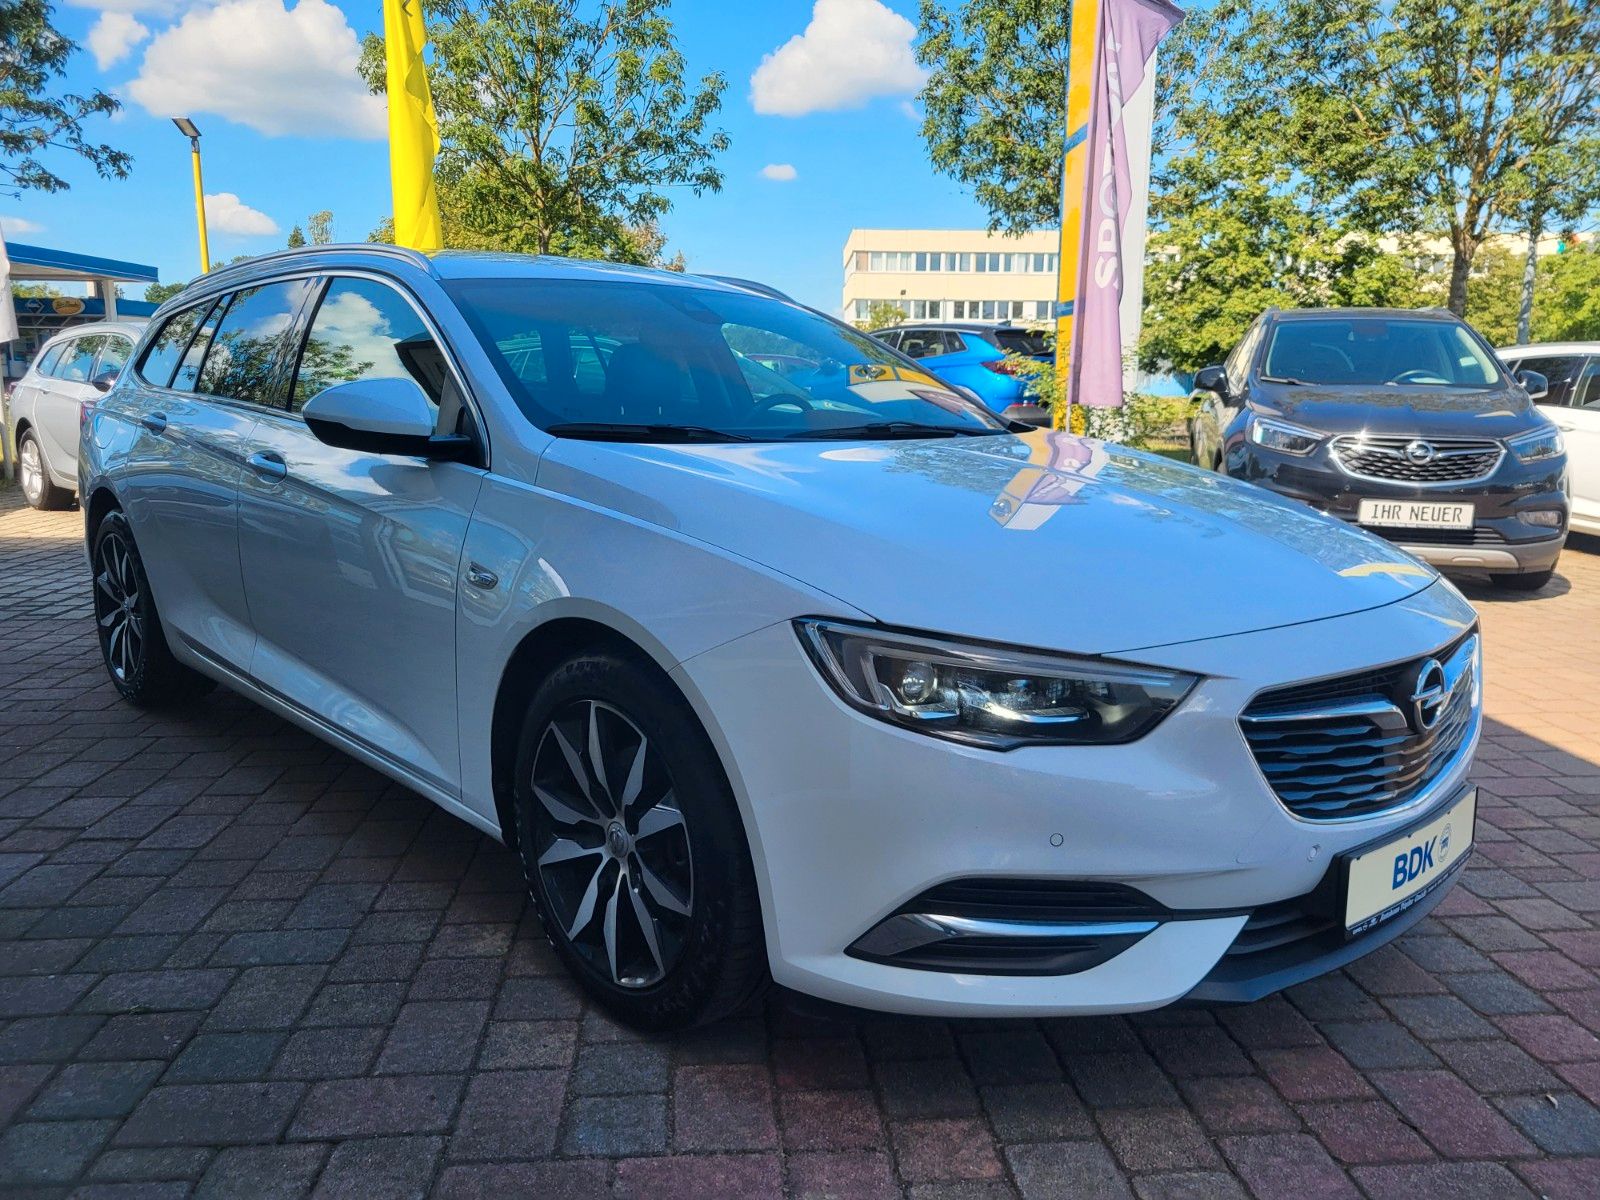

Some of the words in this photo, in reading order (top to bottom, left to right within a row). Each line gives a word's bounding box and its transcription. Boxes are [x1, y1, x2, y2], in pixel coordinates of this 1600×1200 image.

[1371, 504, 1402, 520] IHR
[1409, 505, 1463, 522] NEUER
[1392, 835, 1437, 890] BDK
